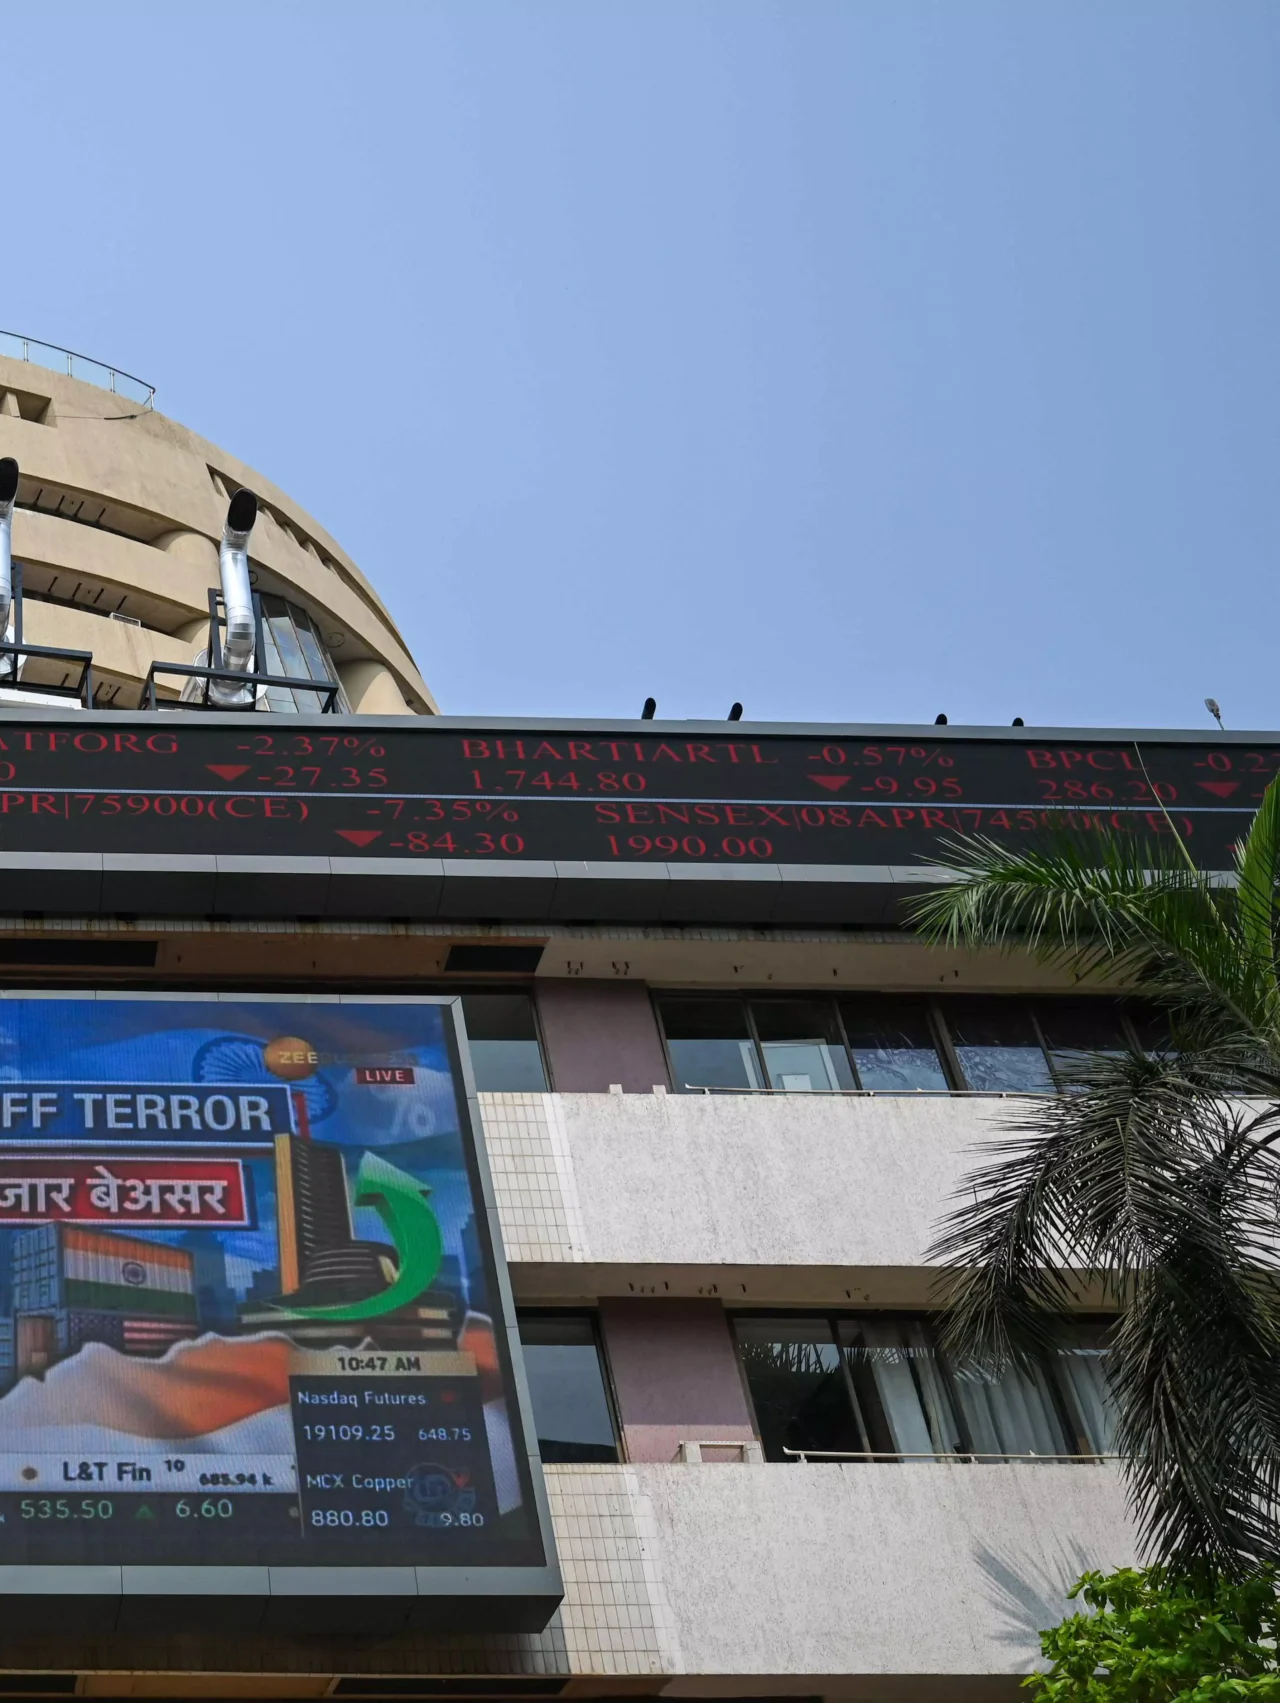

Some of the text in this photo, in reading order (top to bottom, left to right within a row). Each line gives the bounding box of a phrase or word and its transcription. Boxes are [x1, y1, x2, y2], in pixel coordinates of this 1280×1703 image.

[236, 735, 387, 758] -2.37%
[460, 739, 955, 768] BHARTIARTL -0.57%
[1026, 749, 1150, 772] BPCL
[256, 764, 389, 787] -27.35
[470, 769, 964, 799] 1,744.80 -9.95
[1037, 778, 1179, 802] 286.20
[367, 800, 520, 824] -7.35%
[388, 832, 526, 855] -84.30
[607, 834, 775, 860] 1990.00
[279, 1051, 318, 1064] ZEE
[366, 1070, 405, 1081] LIVE
[73, 1093, 272, 1131] TERROR
[86, 1166, 228, 1214] बेअसर
[337, 1356, 421, 1371] 10:47 AM
[297, 1391, 426, 1407] Nasdaq Futures
[303, 1425, 472, 1441] 19109.25 648.75
[62, 1461, 109, 1482] L&T
[116, 1461, 152, 1482] Fin
[164, 1459, 186, 1473] 10
[306, 1474, 415, 1491] MCX Copper
[20, 1500, 113, 1519] 535.50
[175, 1499, 233, 1518] 6.60
[311, 1510, 484, 1527] 880.80 9.80
